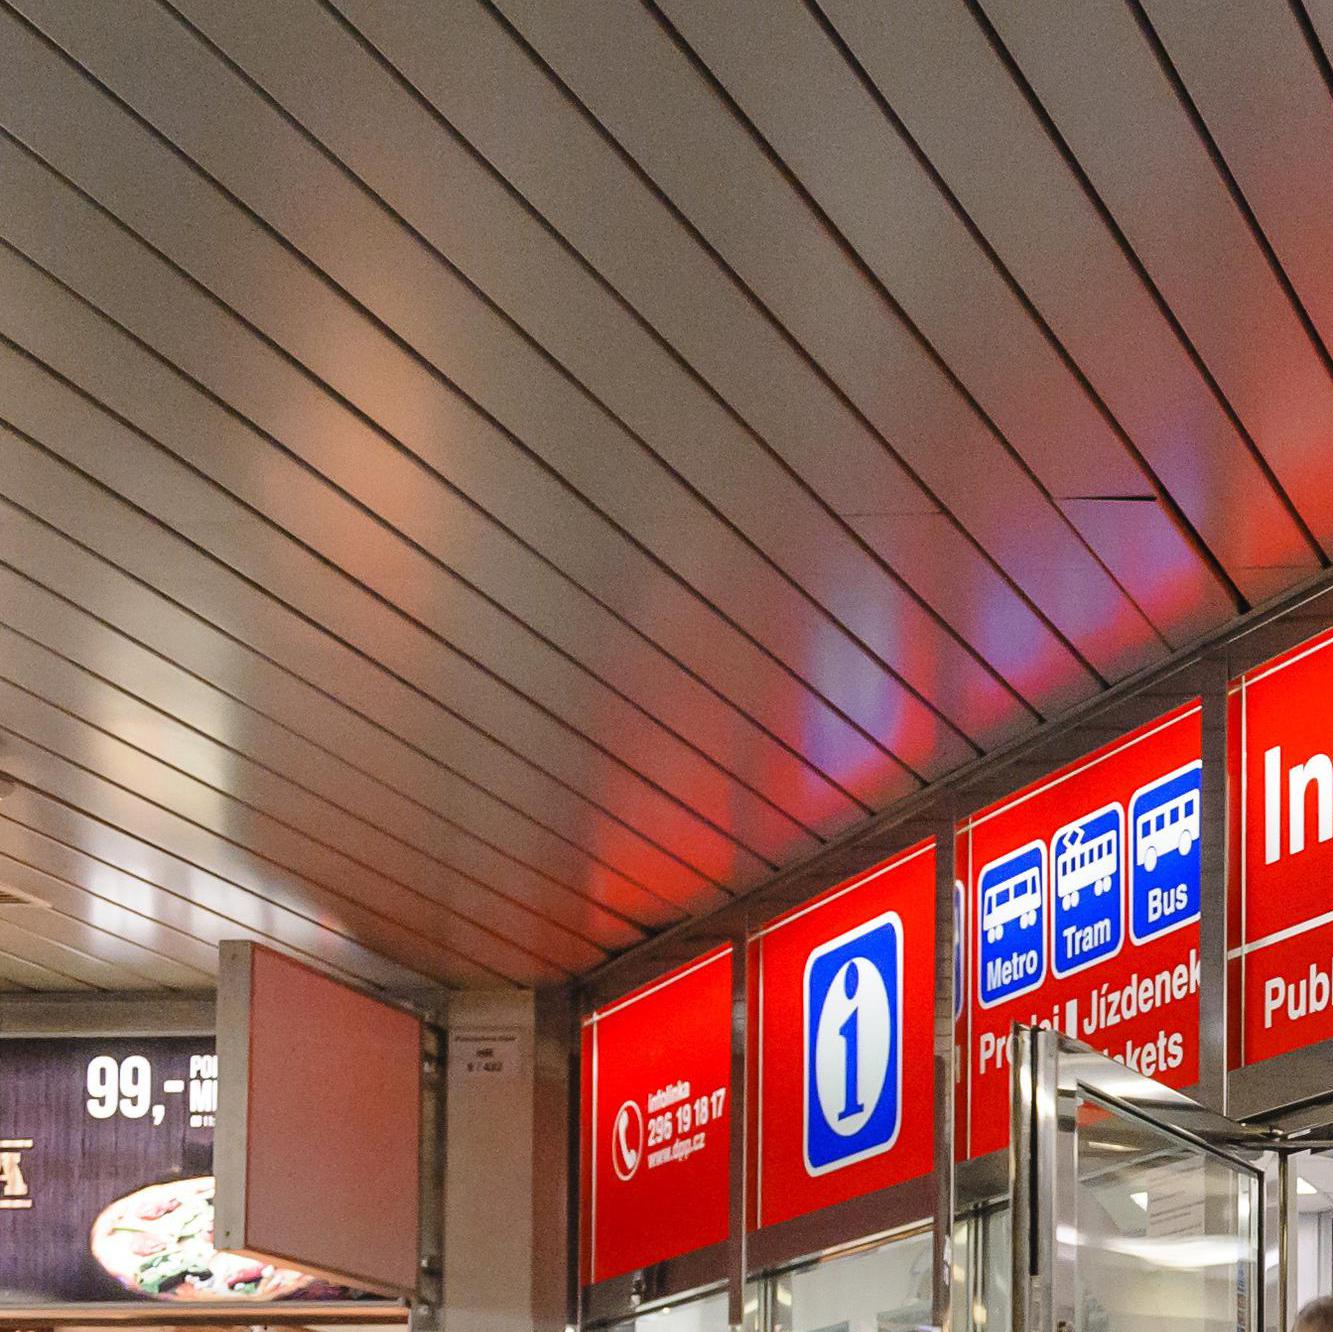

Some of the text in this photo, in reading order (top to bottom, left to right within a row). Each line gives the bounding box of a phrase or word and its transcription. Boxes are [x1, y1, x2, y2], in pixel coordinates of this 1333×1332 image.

[1147, 883, 1188, 924] Bus
[1062, 918, 1112, 959] Tram
[986, 950, 1038, 992] Metro
[86, 1055, 185, 1126] 99,-
[648, 1088, 726, 1147] 296 19 18 17
